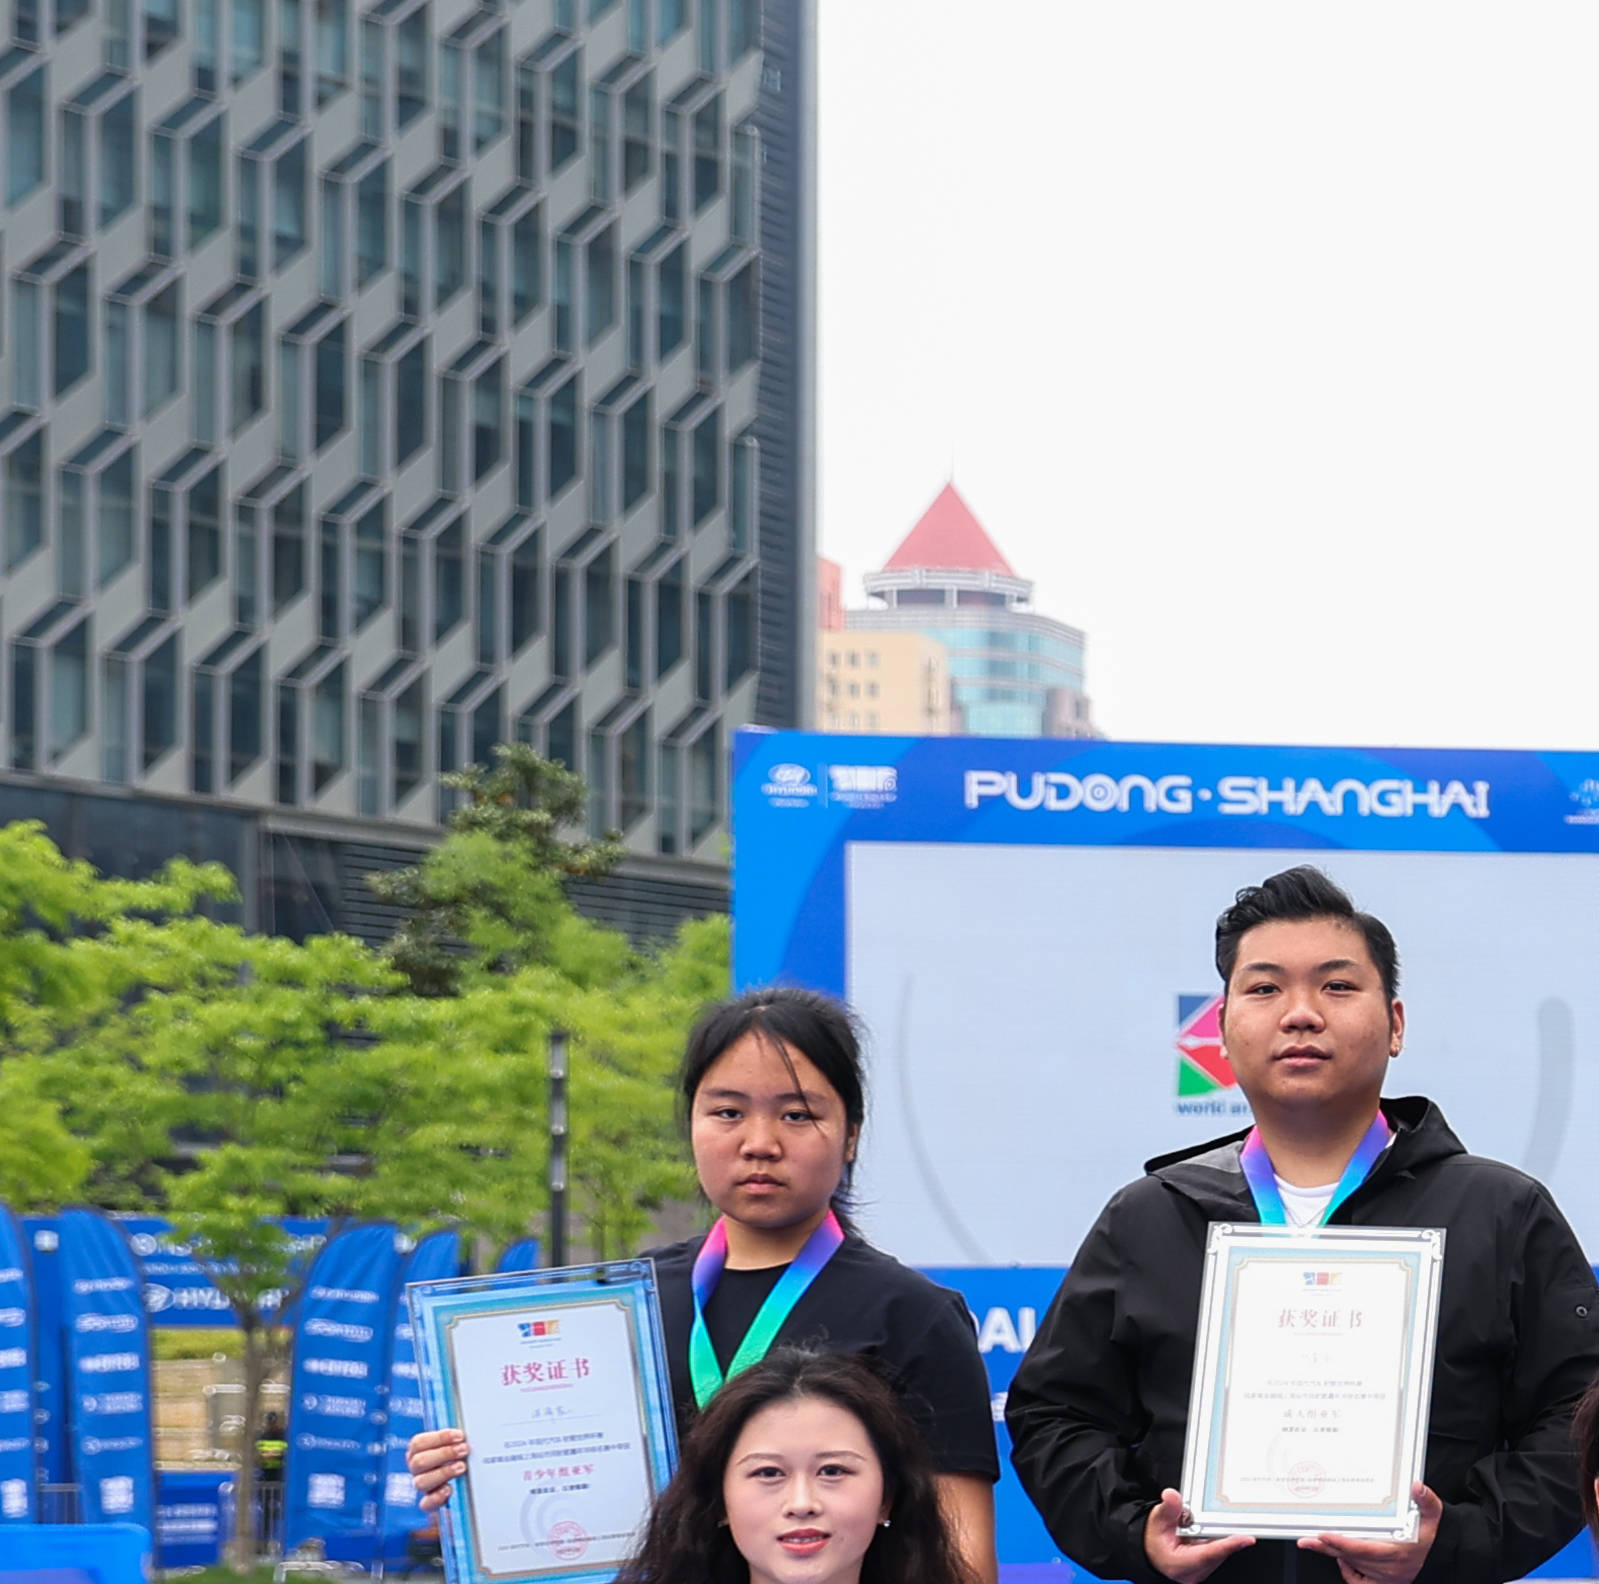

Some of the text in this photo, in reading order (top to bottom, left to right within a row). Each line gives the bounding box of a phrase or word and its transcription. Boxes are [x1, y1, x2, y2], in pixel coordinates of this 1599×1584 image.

[964, 769, 1490, 817] PUDONG SHANGHAI
[1277, 1309, 1364, 1329] 获奖证书
[502, 1358, 590, 1386] 获奖证书
